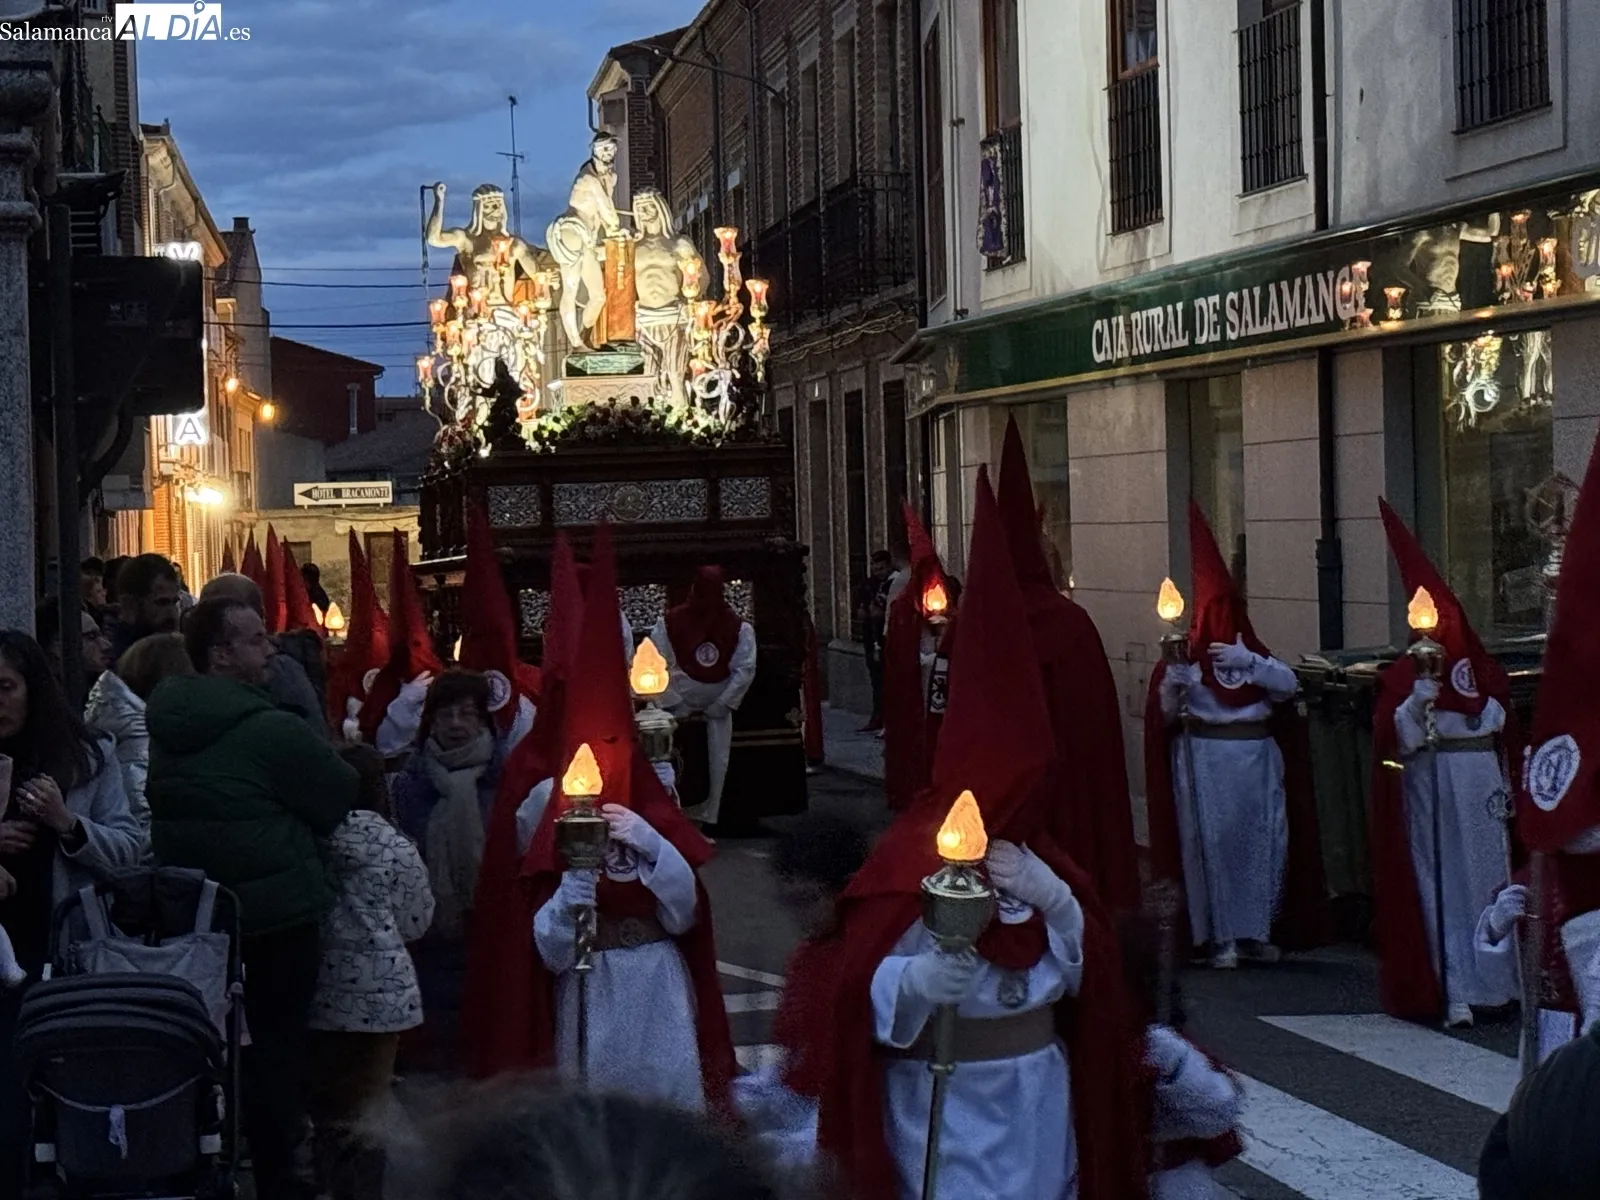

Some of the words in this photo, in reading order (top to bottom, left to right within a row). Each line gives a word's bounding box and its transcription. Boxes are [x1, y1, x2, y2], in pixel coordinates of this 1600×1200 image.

[1092, 315, 1129, 364] CAJA
[1130, 301, 1190, 354] RURAL
[1194, 294, 1222, 345] DE
[311, 487, 336, 500] HOTEL
